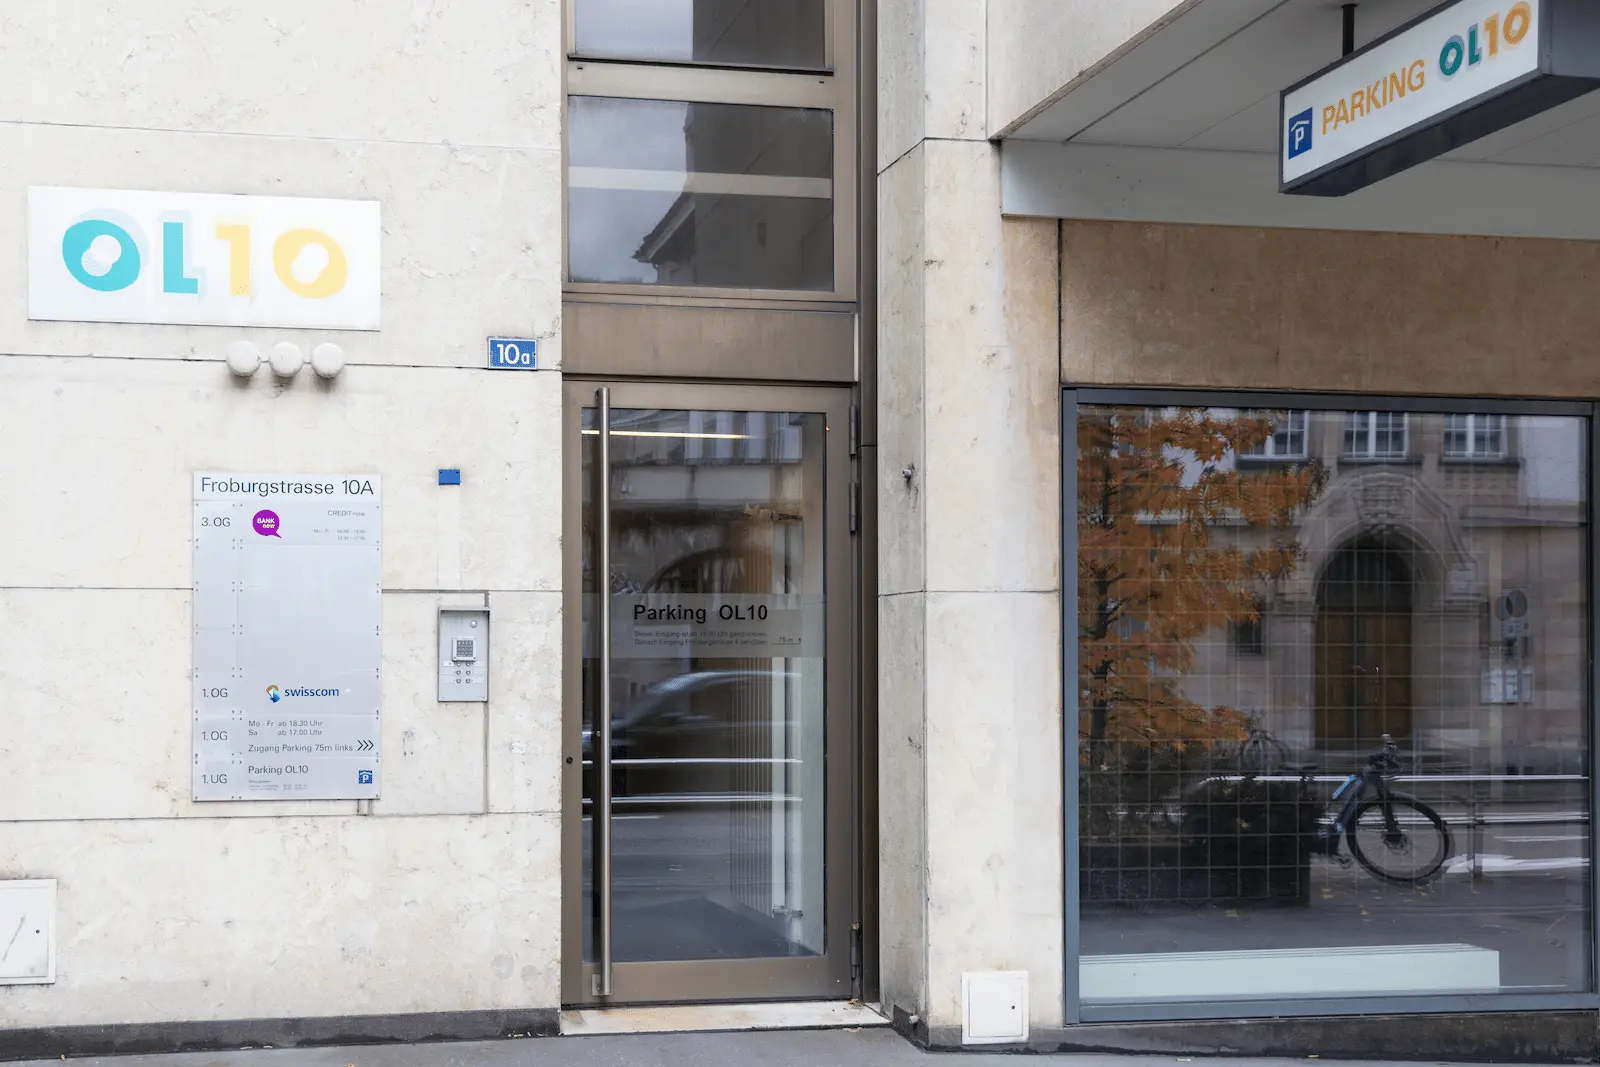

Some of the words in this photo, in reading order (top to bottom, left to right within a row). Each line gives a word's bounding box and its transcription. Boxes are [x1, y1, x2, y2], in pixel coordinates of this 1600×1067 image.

[1322, 60, 1426, 136] PARKING
[1439, 3, 1531, 77] OL10
[61, 212, 348, 299] OL10
[496, 343, 530, 365] 10a
[202, 477, 335, 497] Froburgstrasse
[342, 479, 374, 495] 10A
[633, 604, 707, 624] Parking
[719, 604, 768, 620] OL10
[284, 686, 340, 697] swisscom
[248, 744, 280, 754] Zugang
[282, 744, 313, 754] Parking
[315, 744, 333, 752] 75m
[335, 744, 354, 753] links
[248, 766, 283, 776] Parking
[285, 765, 309, 774] OL10
